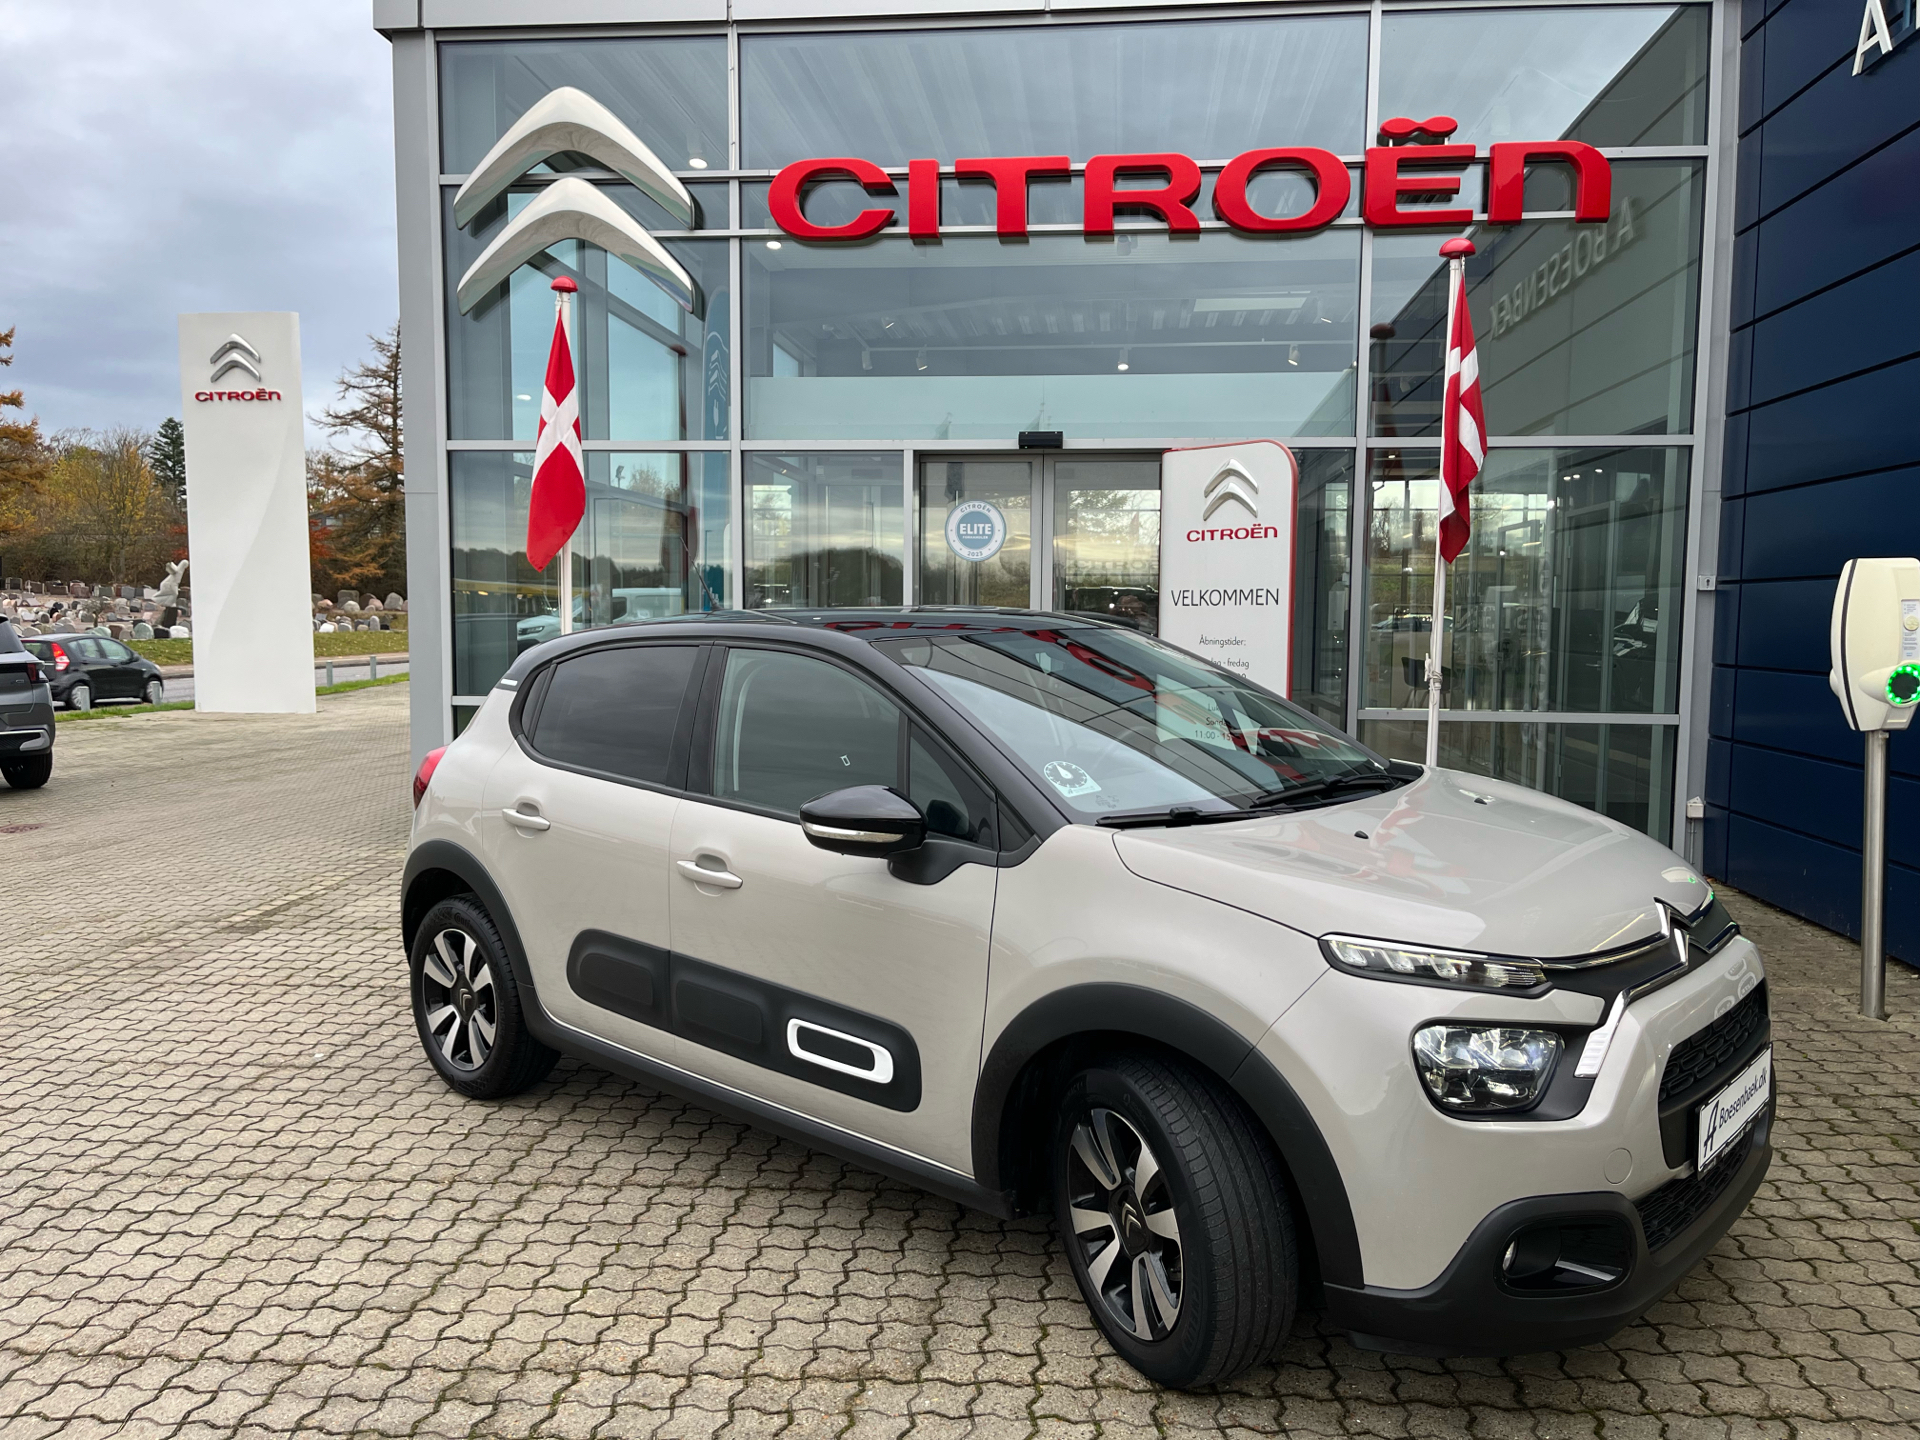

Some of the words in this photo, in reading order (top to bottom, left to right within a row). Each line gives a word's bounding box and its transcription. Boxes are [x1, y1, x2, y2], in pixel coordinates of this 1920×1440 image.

[959, 523, 992, 535] ELITE
[1171, 588, 1279, 606] VELKOMMEN
[1227, 657, 1250, 670] fredag
